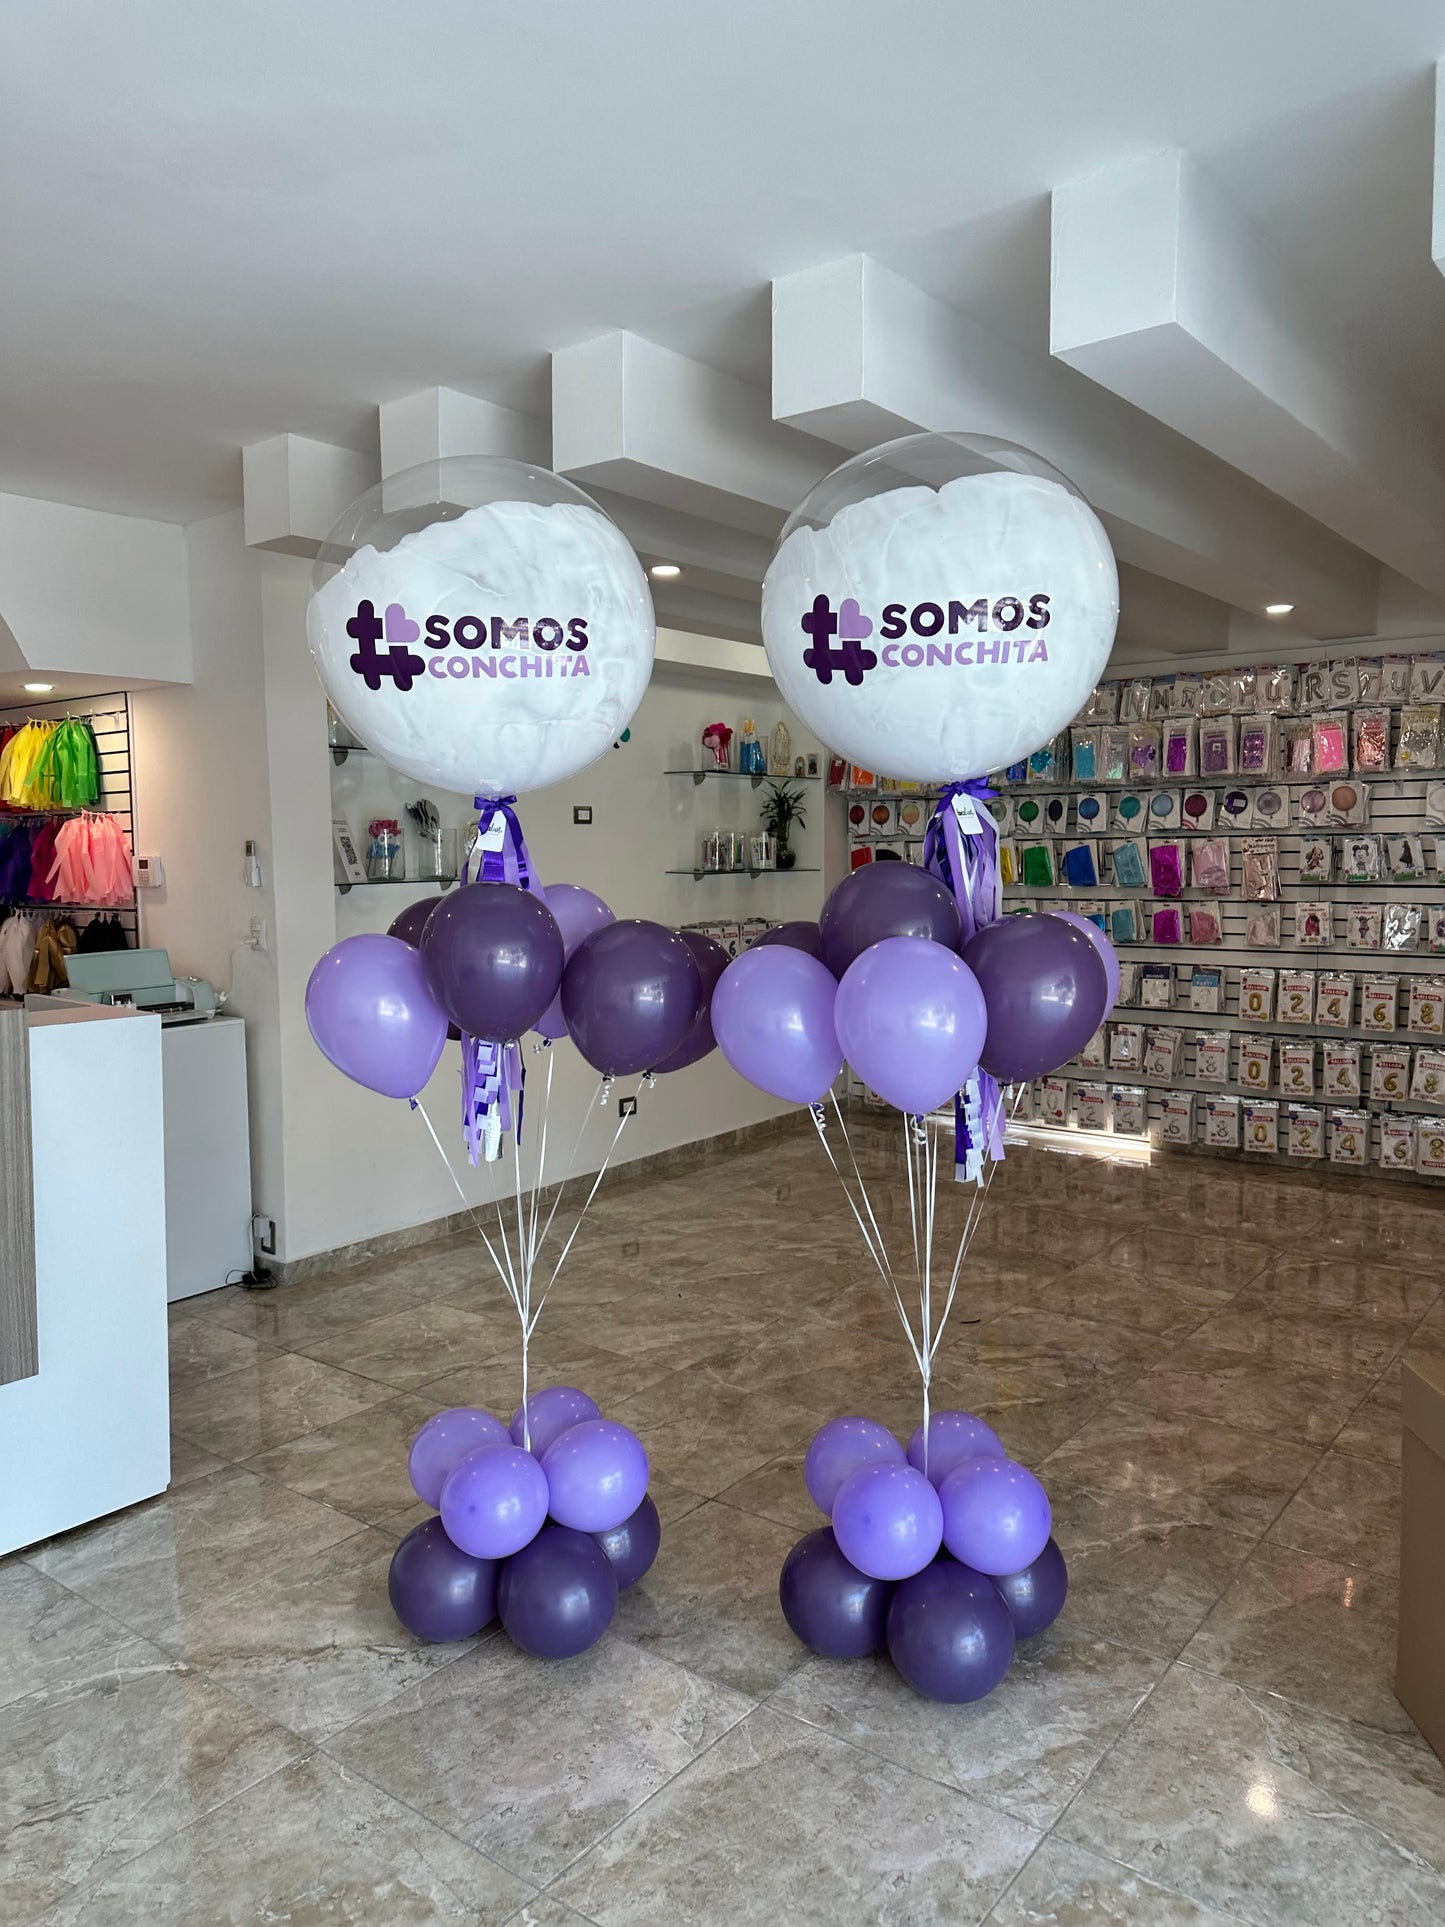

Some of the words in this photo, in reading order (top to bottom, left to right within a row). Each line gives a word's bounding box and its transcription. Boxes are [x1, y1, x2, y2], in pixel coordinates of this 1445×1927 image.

[880, 594, 1051, 639] SOMOS
[423, 614, 589, 652] SOMOS
[881, 639, 1049, 668] CONCHITA
[428, 654, 591, 680] CONCHITA
[1305, 671, 1325, 702] R
[1331, 669, 1352, 700] S
[1390, 671, 1407, 695] U
[1420, 669, 1444, 694] V
[1249, 992, 1263, 1012] 0
[1290, 993, 1304, 1014] 2
[1327, 998, 1341, 1018] 4
[1373, 1003, 1387, 1022] 6
[1420, 1003, 1434, 1024] 8
[1154, 1057, 1165, 1073] 6
[1205, 1056, 1217, 1073] 8
[1248, 1060, 1261, 1080] 0
[1291, 1065, 1305, 1086] 2
[1336, 1067, 1350, 1087] 4
[1384, 1072, 1398, 1092] 6
[1423, 1072, 1440, 1094] 8
[1168, 1119, 1180, 1135] 6
[1217, 1120, 1228, 1138] 8
[1254, 1123, 1267, 1142] 0
[1298, 1127, 1312, 1148] 2
[1340, 1134, 1356, 1156] 4
[1393, 1139, 1407, 1159] 6
[1429, 1138, 1444, 1160] 8
